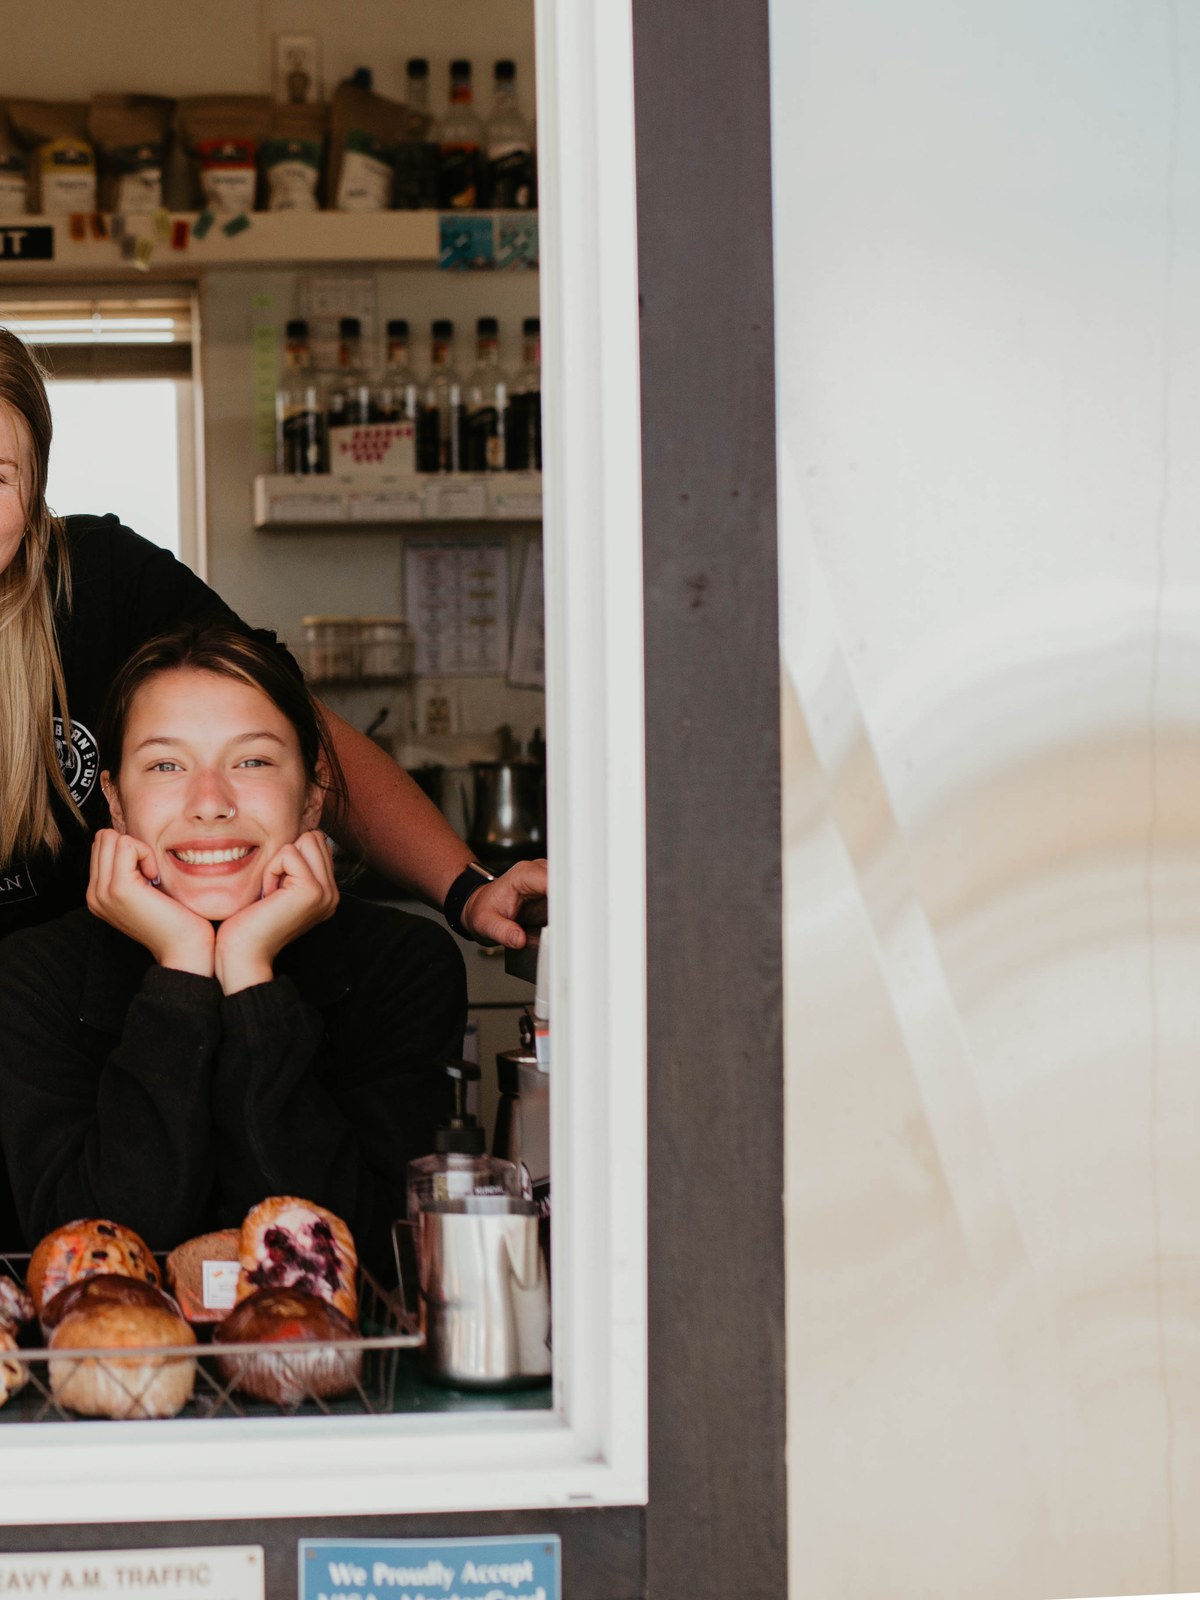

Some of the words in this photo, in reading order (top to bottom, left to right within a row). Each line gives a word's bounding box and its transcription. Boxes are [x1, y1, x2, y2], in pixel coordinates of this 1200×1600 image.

[55, 724, 90, 750] BAN
[60, 1567, 101, 1591] A.M.
[115, 1564, 210, 1590] TRAFFIC
[328, 1561, 367, 1586] We
[372, 1560, 455, 1591] Proudly
[460, 1559, 534, 1589] Accept
